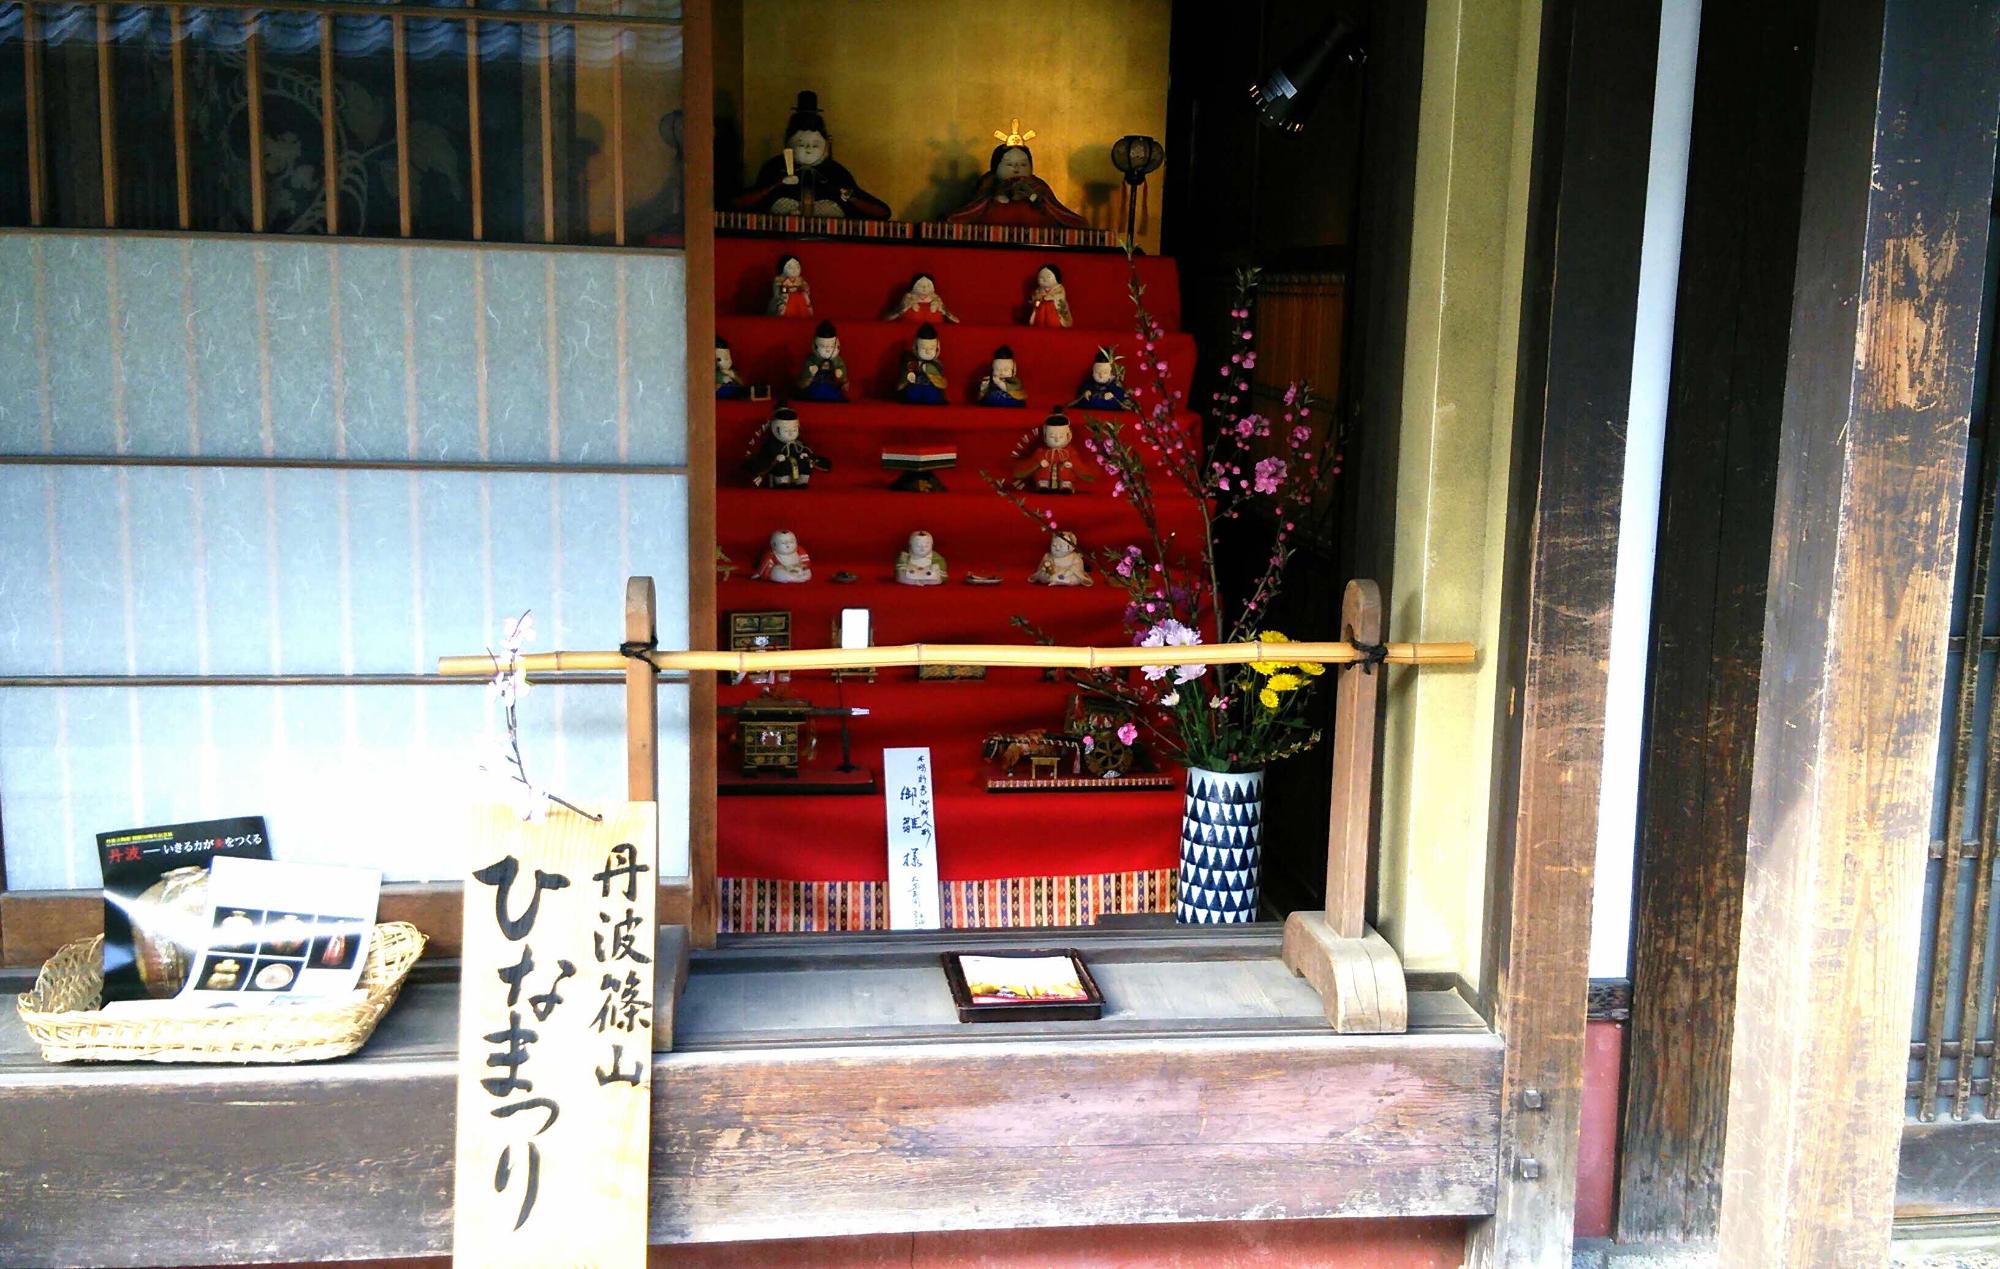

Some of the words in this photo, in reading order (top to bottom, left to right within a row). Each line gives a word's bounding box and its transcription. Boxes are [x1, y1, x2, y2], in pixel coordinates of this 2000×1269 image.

[900, 785, 923, 868] 御雛様
[472, 854, 577, 1232] ひなまつり
[589, 842, 653, 1088] 丹波篠山
